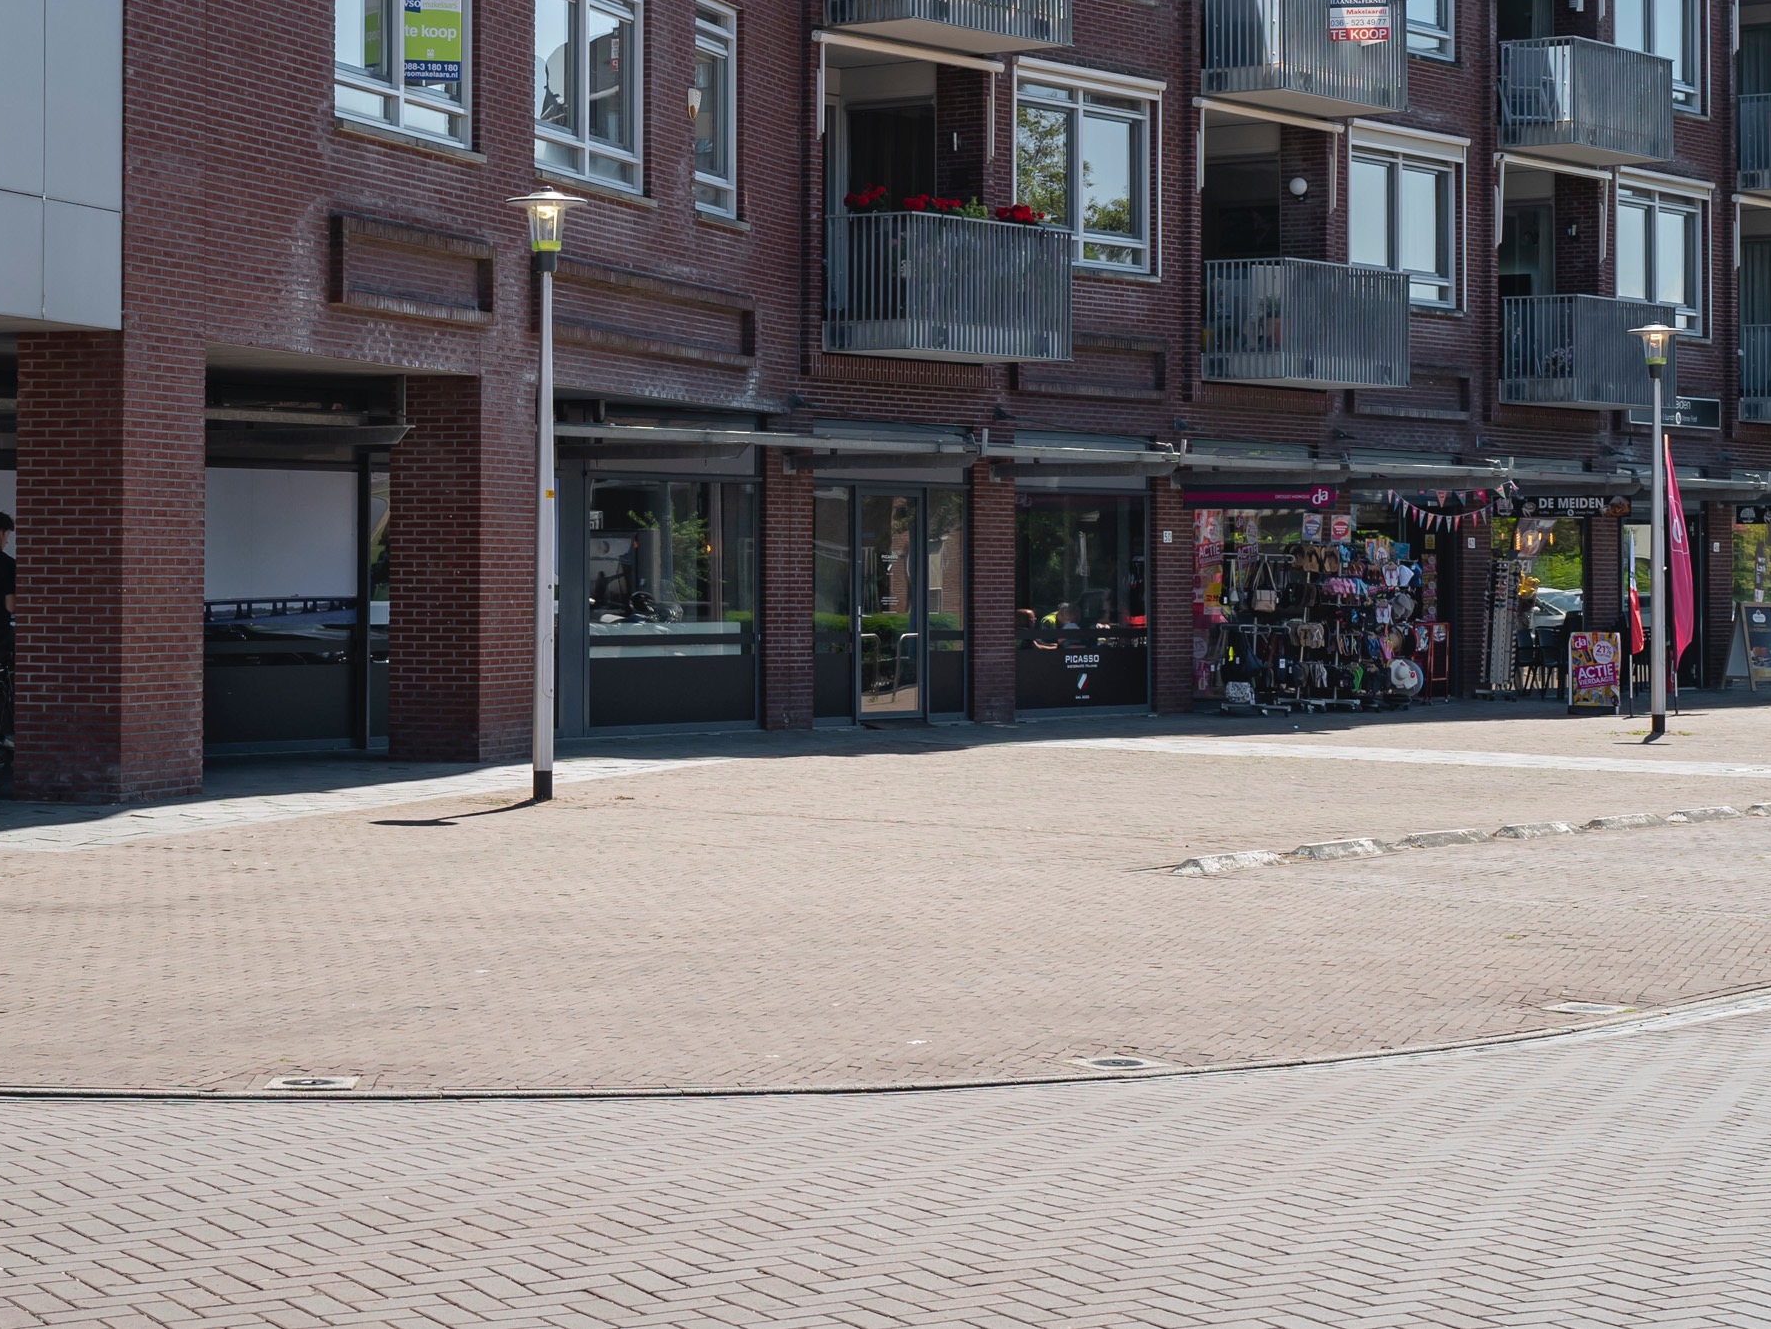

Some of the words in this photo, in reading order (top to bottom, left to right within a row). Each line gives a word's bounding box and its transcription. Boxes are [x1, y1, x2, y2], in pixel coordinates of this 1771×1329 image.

[404, 0, 421, 8] vso
[1330, 19, 1344, 27] 036
[404, 24, 418, 37] te
[421, 24, 457, 42] koop
[1330, 30, 1347, 40] TE
[1350, 29, 1388, 40] KOOP
[428, 63, 442, 71] 180
[443, 63, 458, 72] 180
[1312, 488, 1329, 505] da
[1538, 497, 1554, 509] DE
[1557, 497, 1605, 509] MEIDEN
[1164, 532, 1172, 542] 50
[1198, 544, 1221, 558] ACTIE
[1574, 637, 1587, 649] da
[1065, 654, 1100, 664] PICASSO
[1578, 663, 1614, 680] ACTIE
[1578, 676, 1615, 686] VIERDAAGSE
